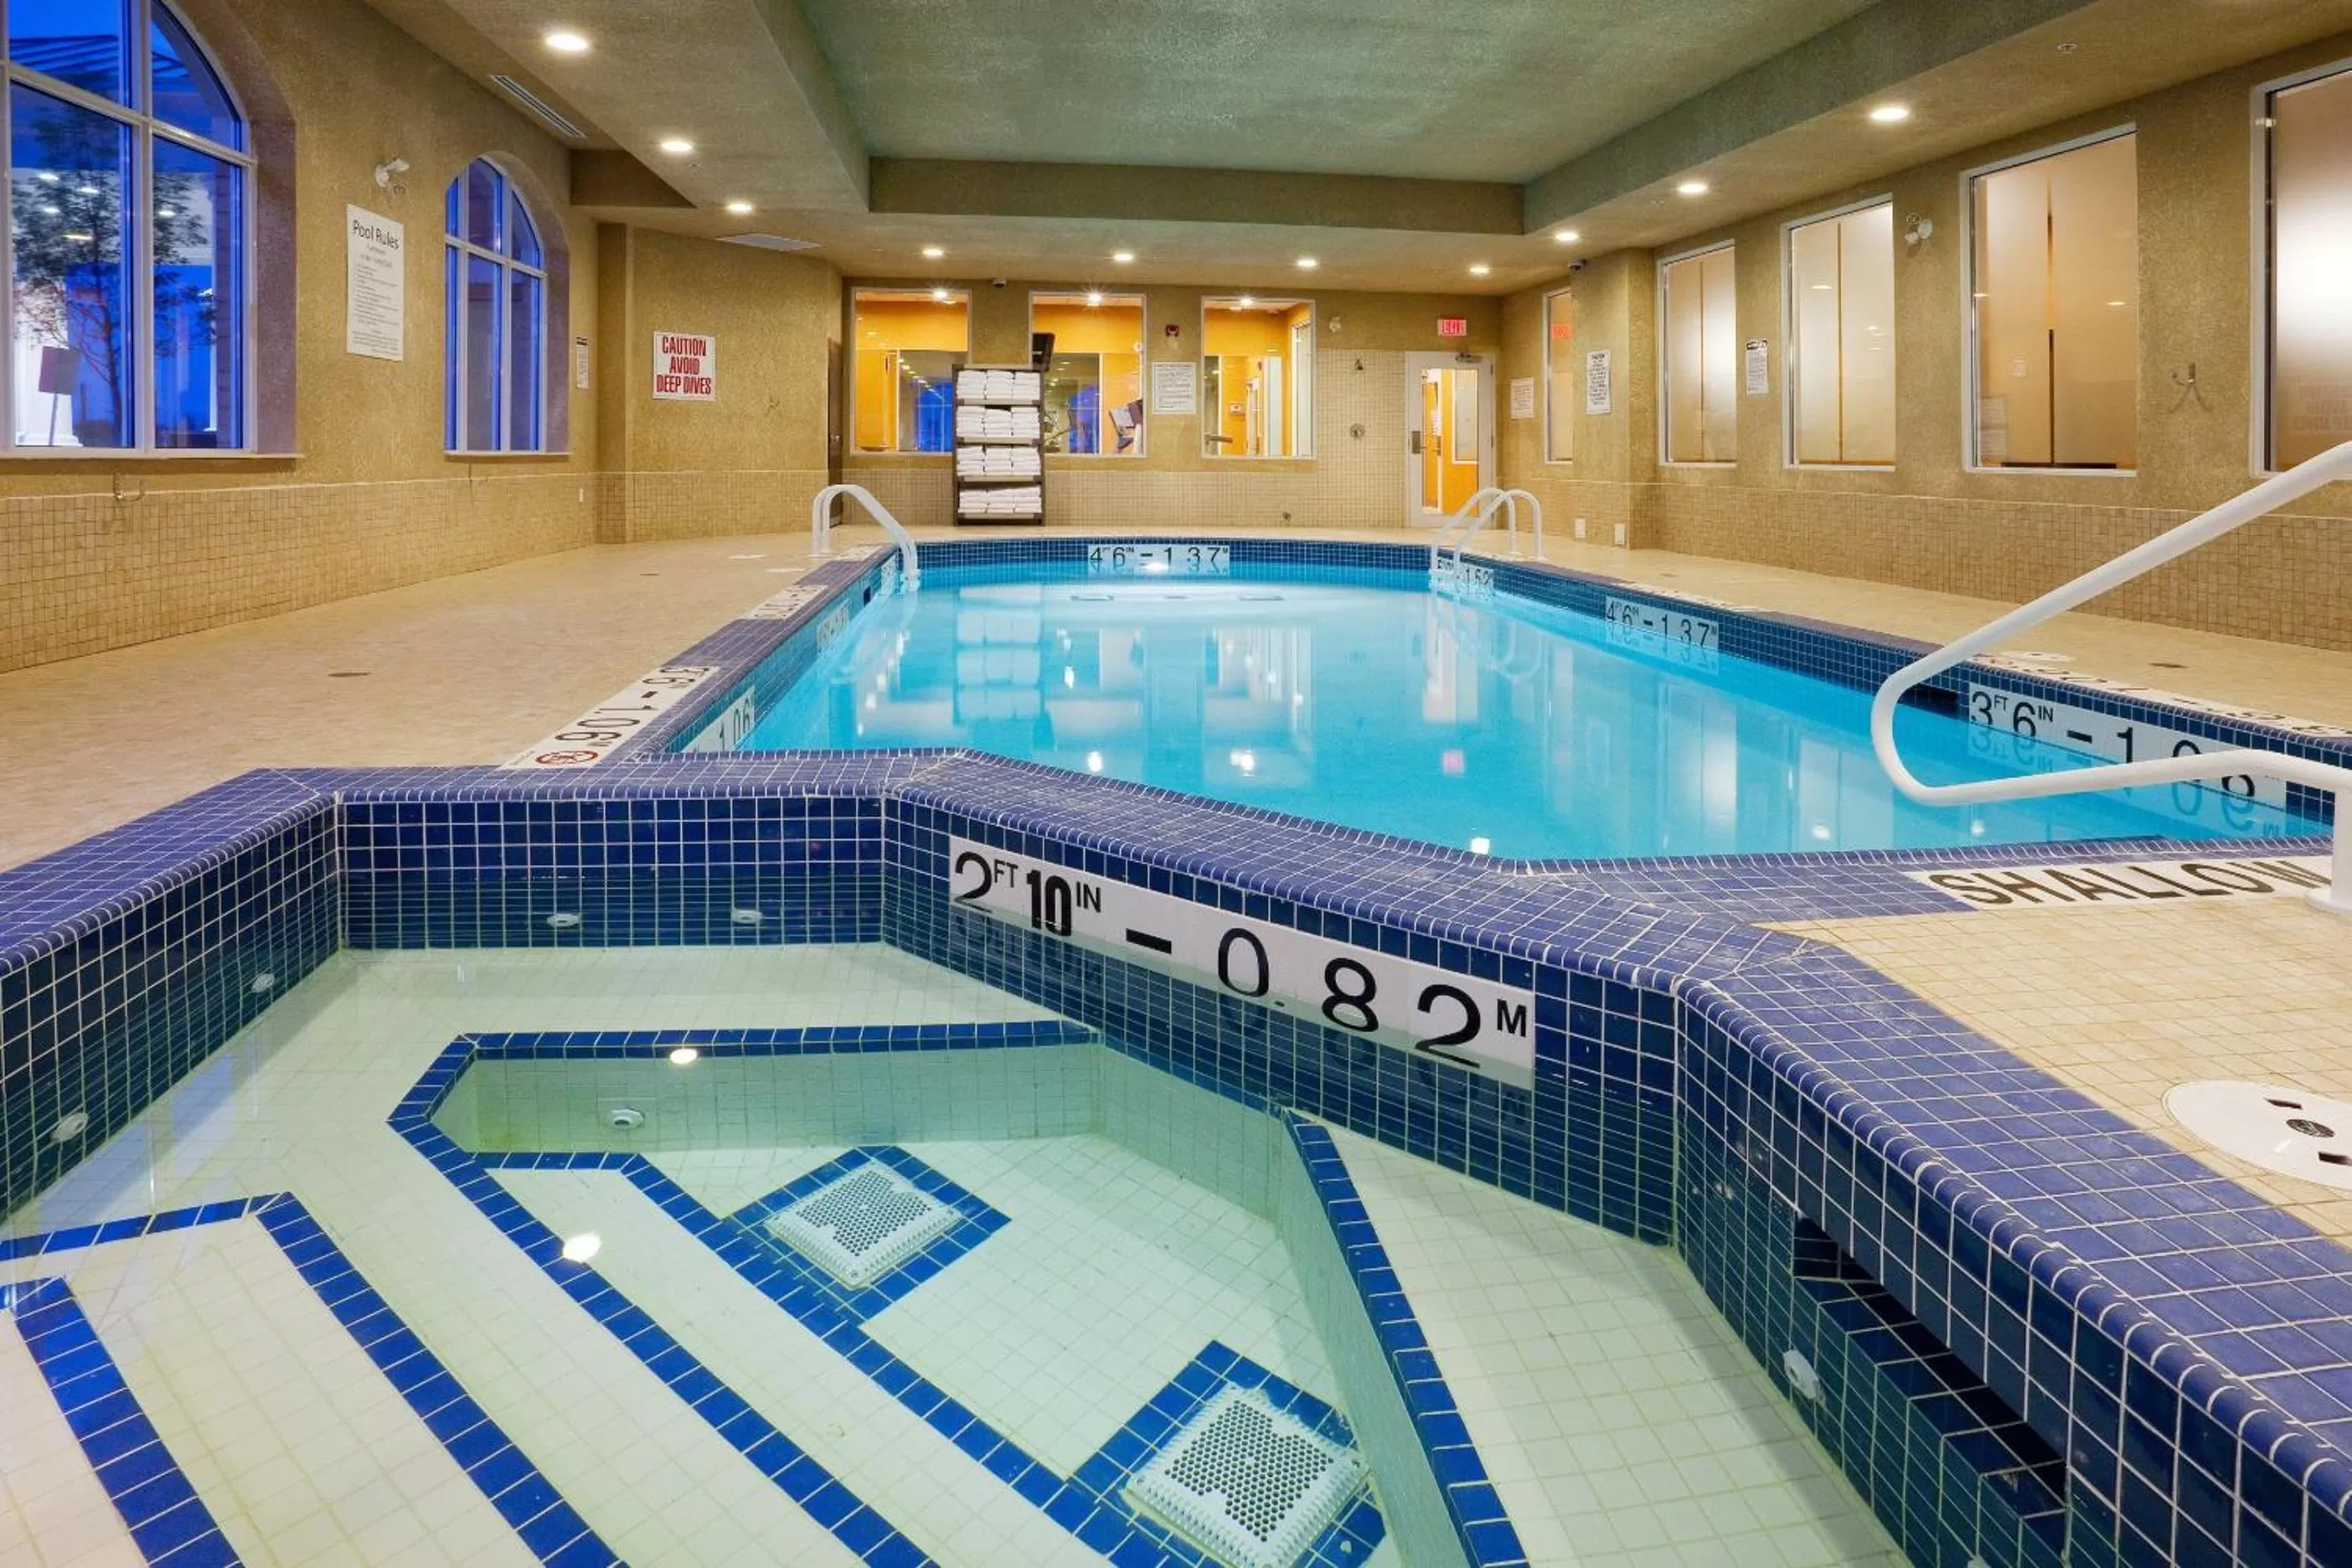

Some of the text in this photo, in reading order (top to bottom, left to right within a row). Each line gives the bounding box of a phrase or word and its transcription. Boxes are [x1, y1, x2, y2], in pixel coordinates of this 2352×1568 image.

[353, 219, 374, 241] Pool
[375, 228, 400, 250] Rules
[663, 337, 707, 357] CAUTION
[669, 357, 700, 375] AVOID
[657, 374, 711, 395] DEEP DIVES
[1929, 860, 2333, 904] SHALLOW
